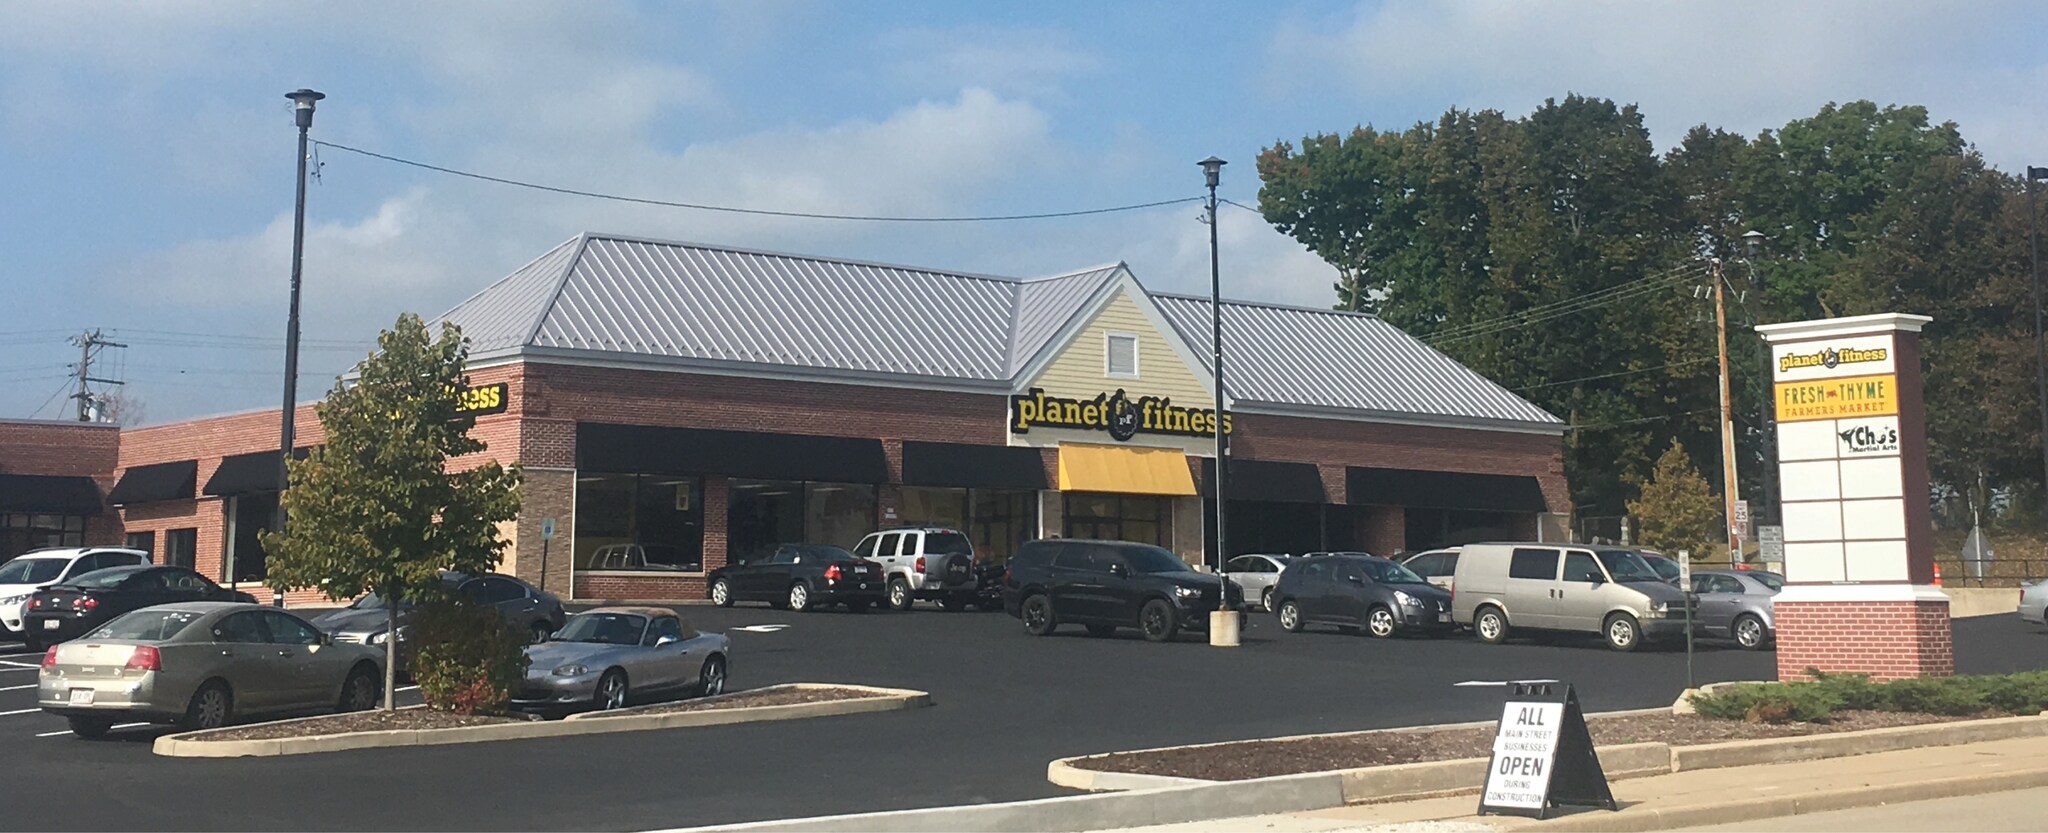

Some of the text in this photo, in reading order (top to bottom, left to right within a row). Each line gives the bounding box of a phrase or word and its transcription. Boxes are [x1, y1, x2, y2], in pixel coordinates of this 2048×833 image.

[1780, 347, 1887, 372] planet fitness
[1784, 381, 1885, 405] FRESH THYME
[1018, 393, 1233, 434] planet fitness
[1785, 402, 1885, 417] FARMERS MARKET
[1853, 445, 1880, 453] Martial
[1735, 511, 1747, 520] 25
[1516, 706, 1545, 726] ALL
[1504, 729, 1552, 740] MAIN STREET
[1503, 742, 1548, 752] BUSINESSES
[1500, 756, 1544, 777] OPEN
[1503, 779, 1531, 789] DURING
[1487, 791, 1543, 803] CONSTRUCTION
